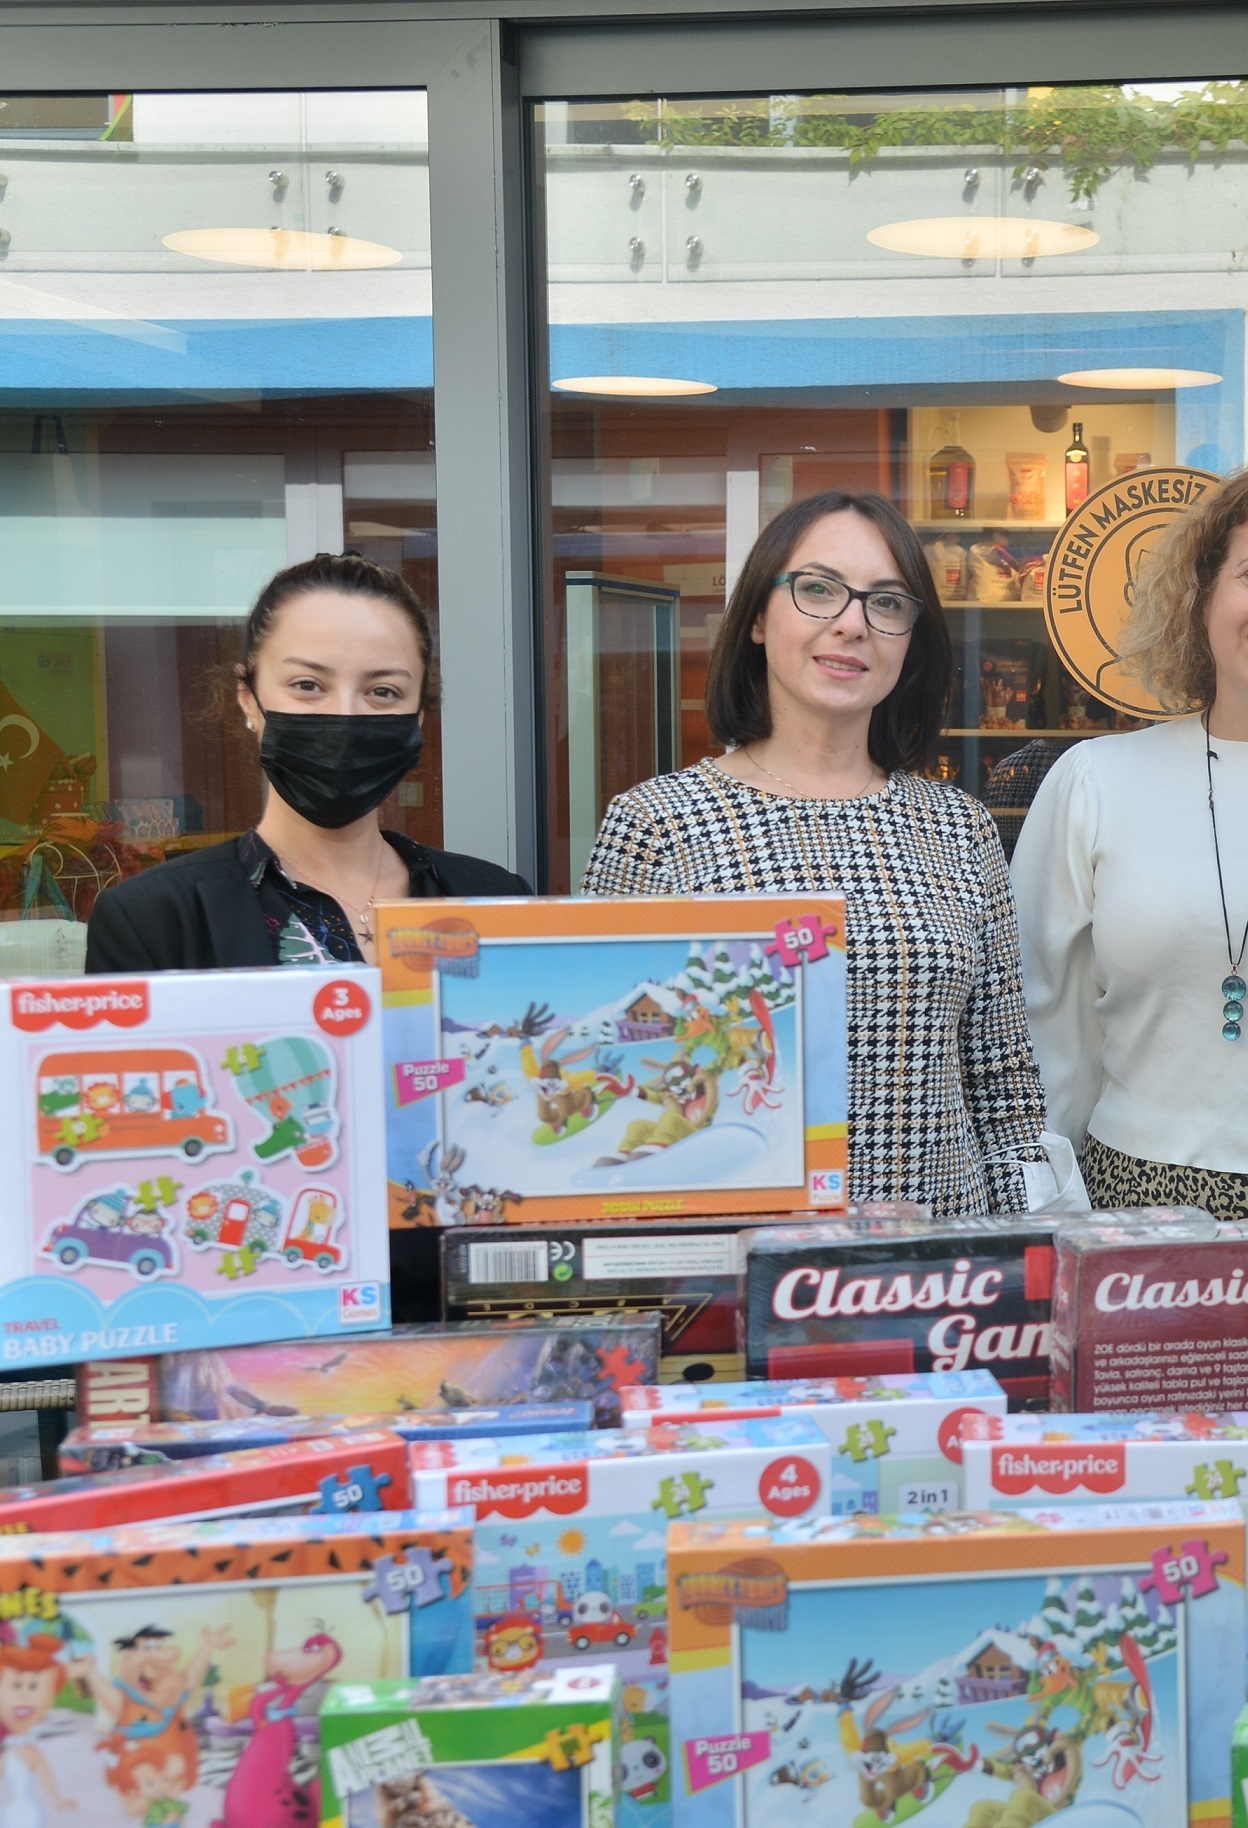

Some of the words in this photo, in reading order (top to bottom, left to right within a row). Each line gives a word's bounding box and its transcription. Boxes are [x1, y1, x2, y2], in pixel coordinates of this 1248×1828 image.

[1052, 523, 1101, 613] LÜTFEN
[784, 927, 814, 949] 50
[18, 990, 144, 1017] fisher-price
[333, 988, 349, 1006] 3
[322, 1007, 362, 1022] Ages
[403, 1061, 450, 1077] Puzzle
[413, 1075, 439, 1094] 50
[812, 1174, 840, 1191] KS
[342, 1286, 377, 1306] KS
[772, 1258, 1003, 1321] Classic
[4, 1318, 61, 1334] TRAVEL
[3, 1333, 74, 1360] BABY
[82, 1323, 179, 1352] PUZZLE
[780, 1463, 798, 1483] 4
[998, 1454, 1119, 1480] fisher-price
[333, 1483, 364, 1507] 50
[454, 1476, 582, 1504] fisher-price
[768, 1481, 811, 1501] Ages
[907, 1491, 918, 1504] 2
[921, 1489, 937, 1503] in
[940, 1489, 949, 1502] 1
[386, 1566, 426, 1592] 50
[1163, 1556, 1199, 1582] 50
[695, 1736, 752, 1757] Puzzle
[707, 1752, 738, 1774] 50
